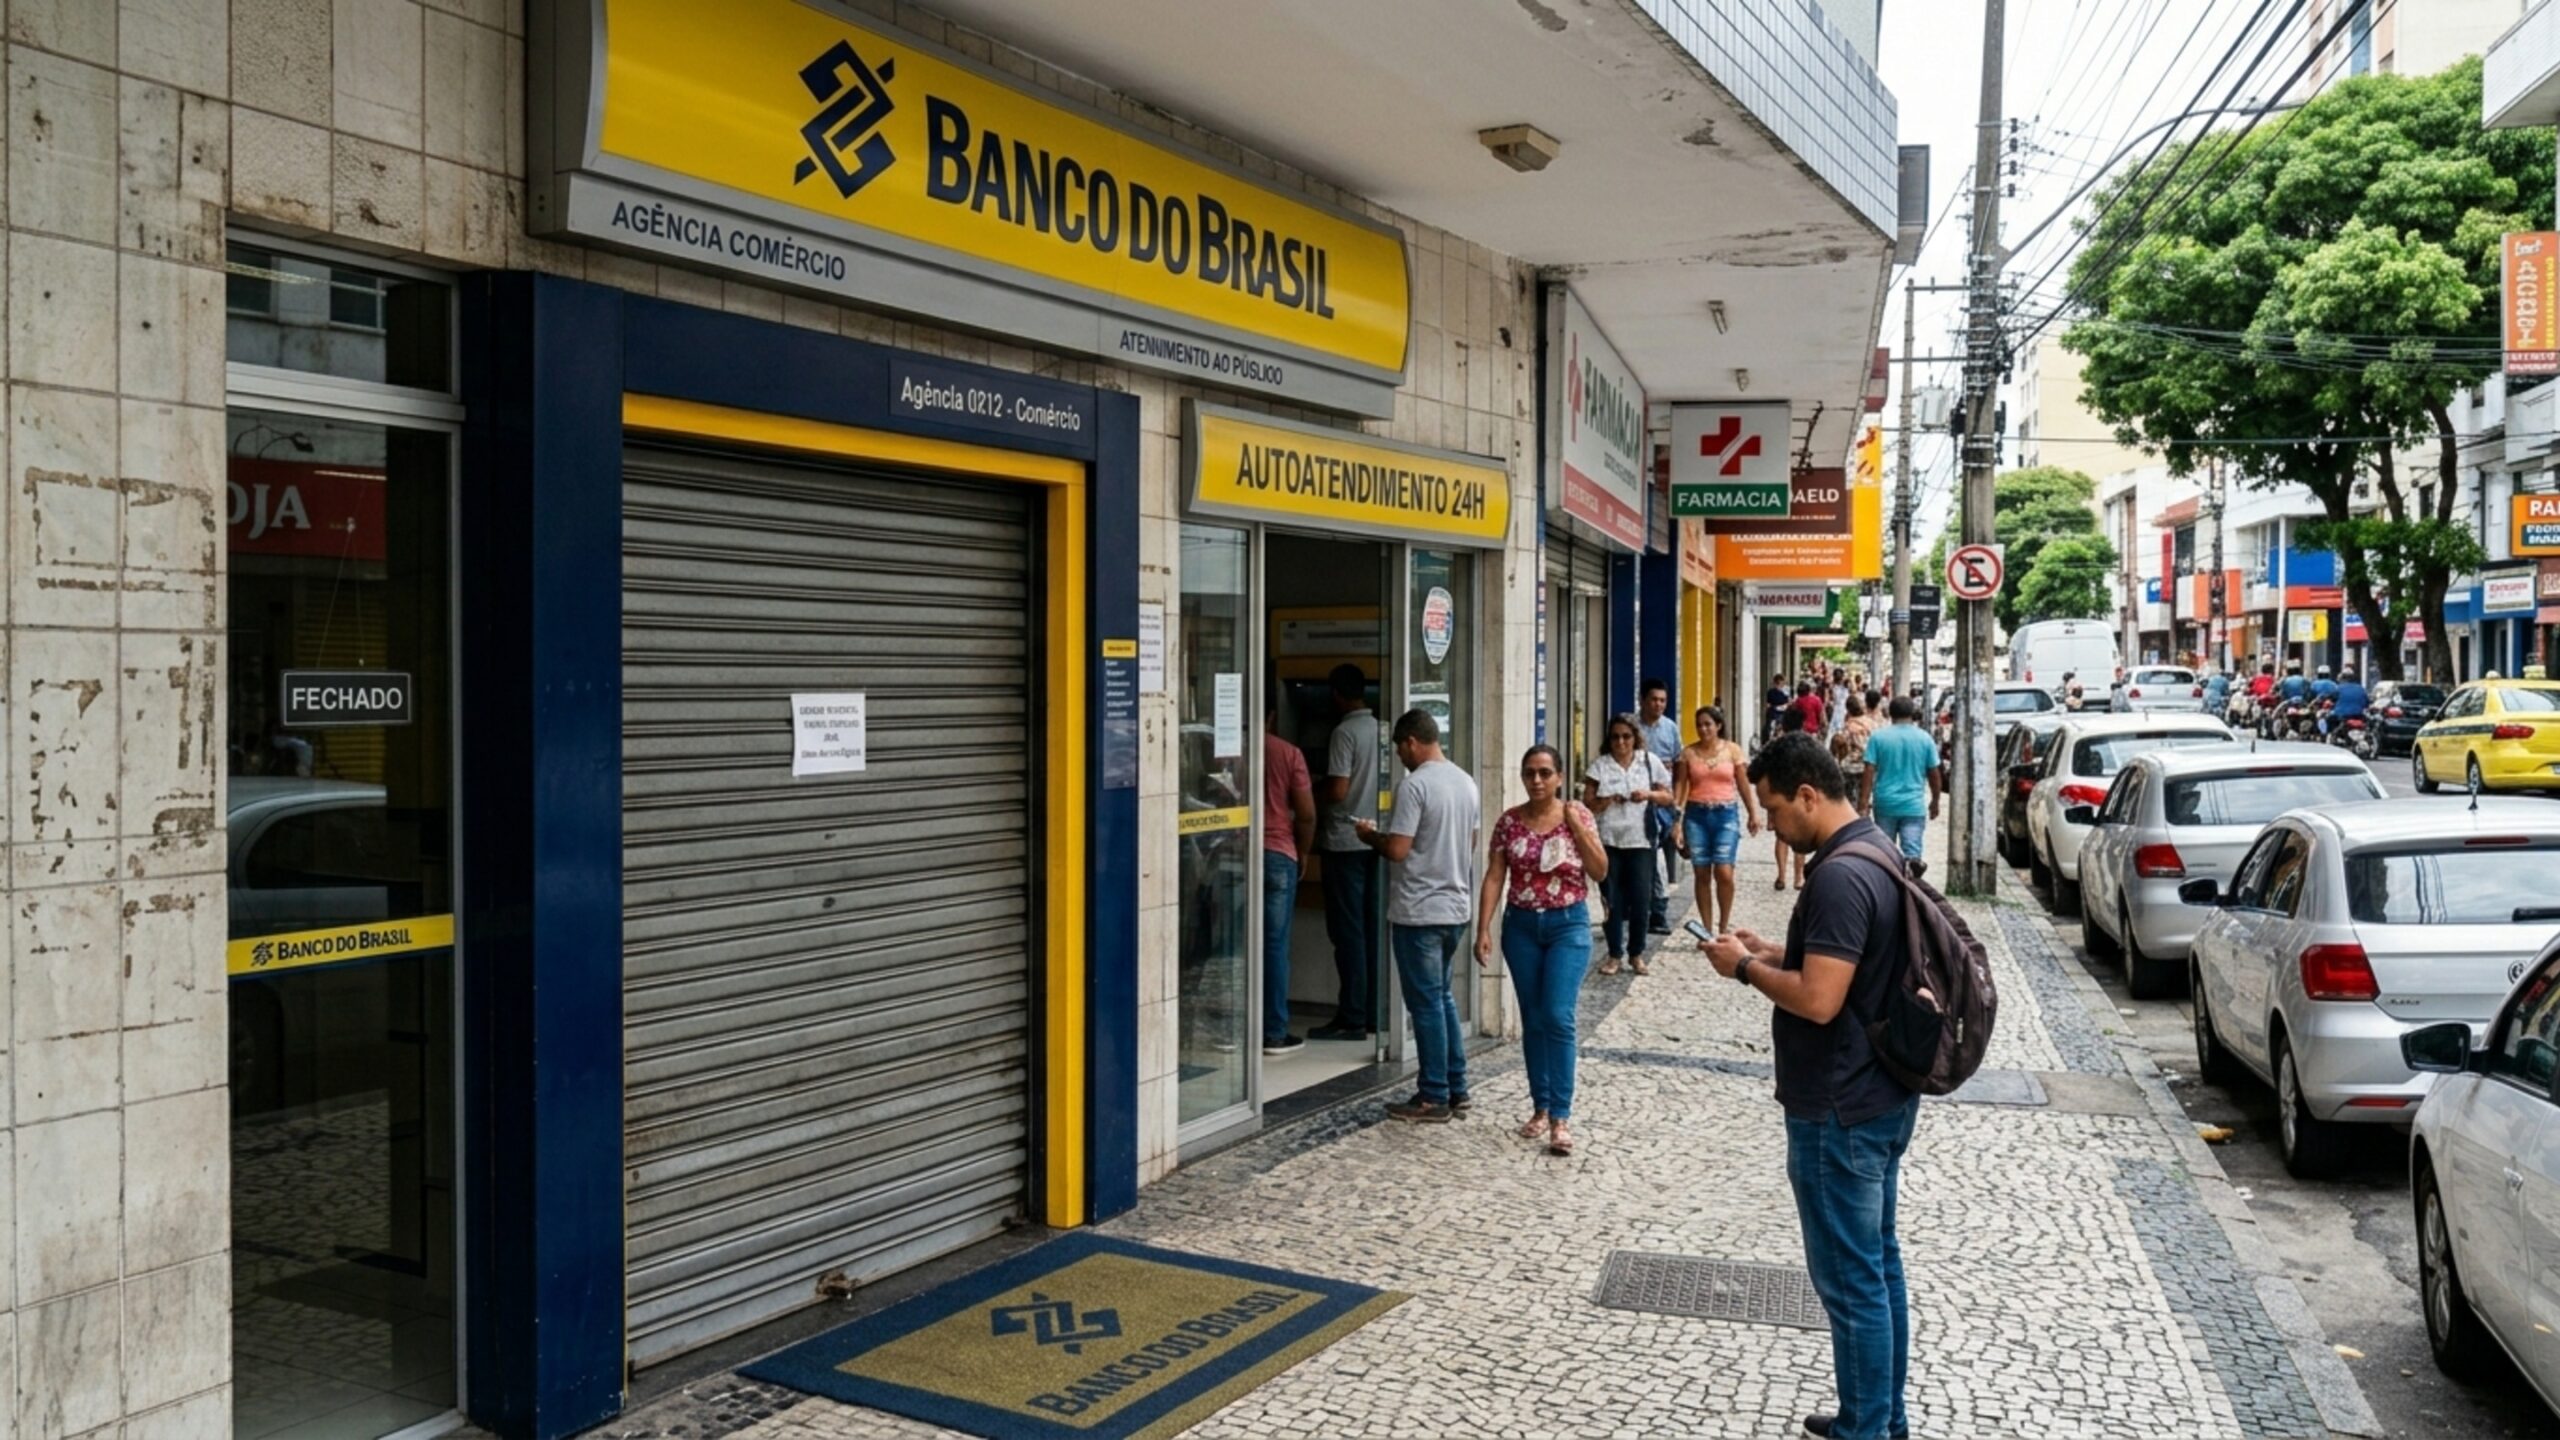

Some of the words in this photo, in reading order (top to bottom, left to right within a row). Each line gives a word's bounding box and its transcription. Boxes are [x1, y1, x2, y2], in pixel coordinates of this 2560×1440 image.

[926, 94, 1120, 253] BANCO
[1129, 181, 1191, 275] DO
[1198, 193, 1335, 320] BRASIL
[611, 200, 724, 253] AGÊNCIA
[729, 229, 847, 282] COMÉRCIO
[1212, 351, 1231, 374] AO
[1235, 442, 1449, 515] AUTOATENDIMENTO
[1452, 478, 1486, 521] 24H
[1677, 490, 1783, 508] FARMÁCIA
[291, 686, 404, 711] FECHADO
[277, 937, 334, 961] BANCO
[336, 934, 356, 953] DO
[358, 928, 413, 949] BRASIL
[1175, 1290, 1301, 1338] BRASIL
